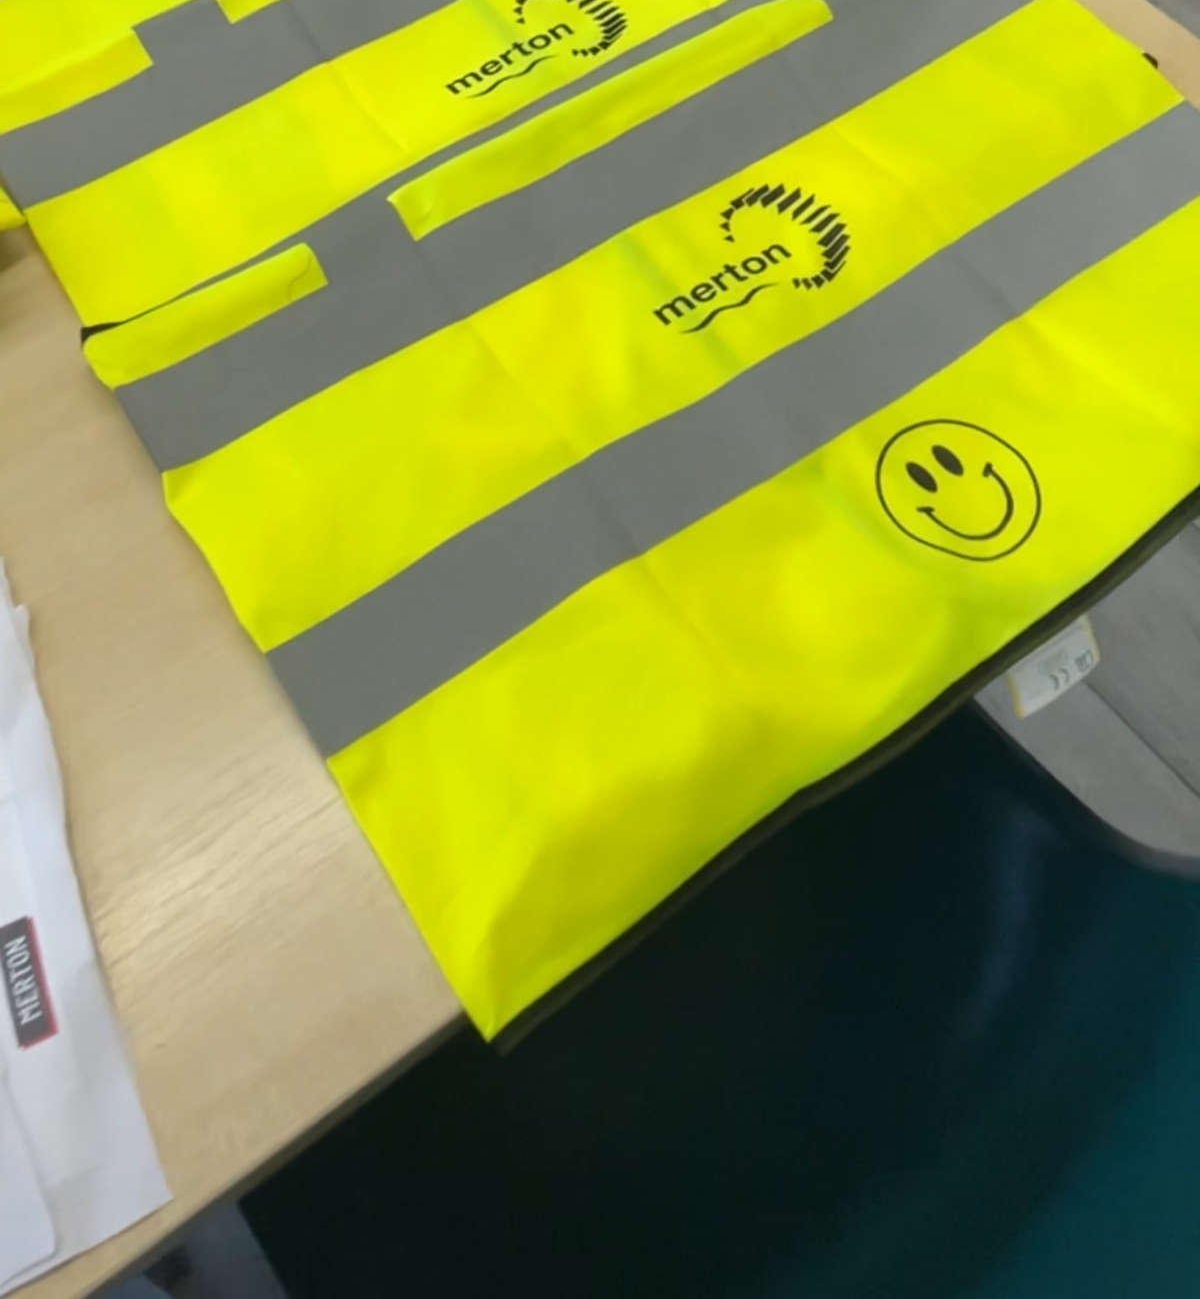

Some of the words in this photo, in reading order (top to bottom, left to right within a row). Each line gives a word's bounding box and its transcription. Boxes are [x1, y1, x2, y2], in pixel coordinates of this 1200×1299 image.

[445, 23, 575, 94] merton
[652, 244, 792, 325] merton
[4, 935, 43, 1025] MERTON
